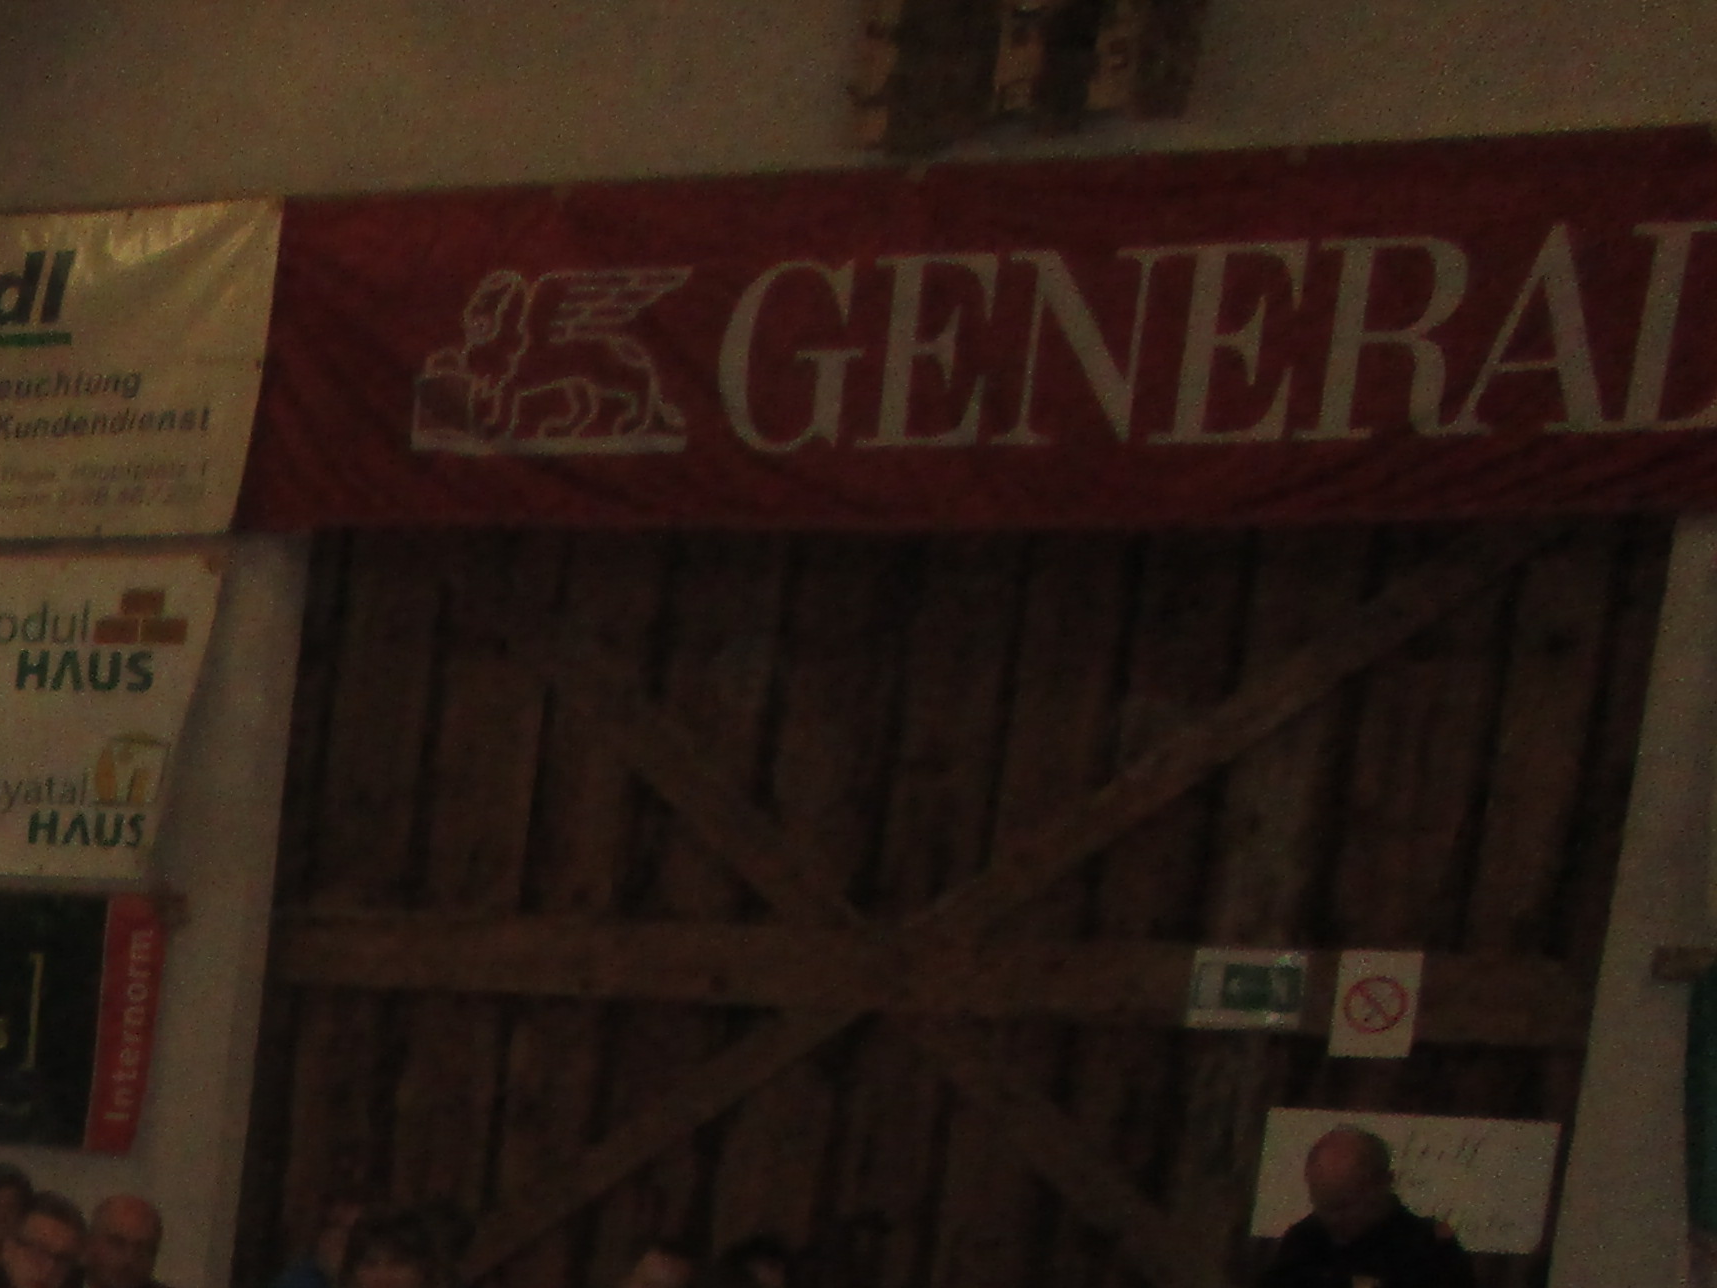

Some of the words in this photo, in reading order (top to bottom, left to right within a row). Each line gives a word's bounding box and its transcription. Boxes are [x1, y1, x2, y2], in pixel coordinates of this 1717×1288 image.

[14, 647, 156, 693] HAUS
[26, 811, 149, 849] HAUS
[102, 926, 157, 1125] Internorm
